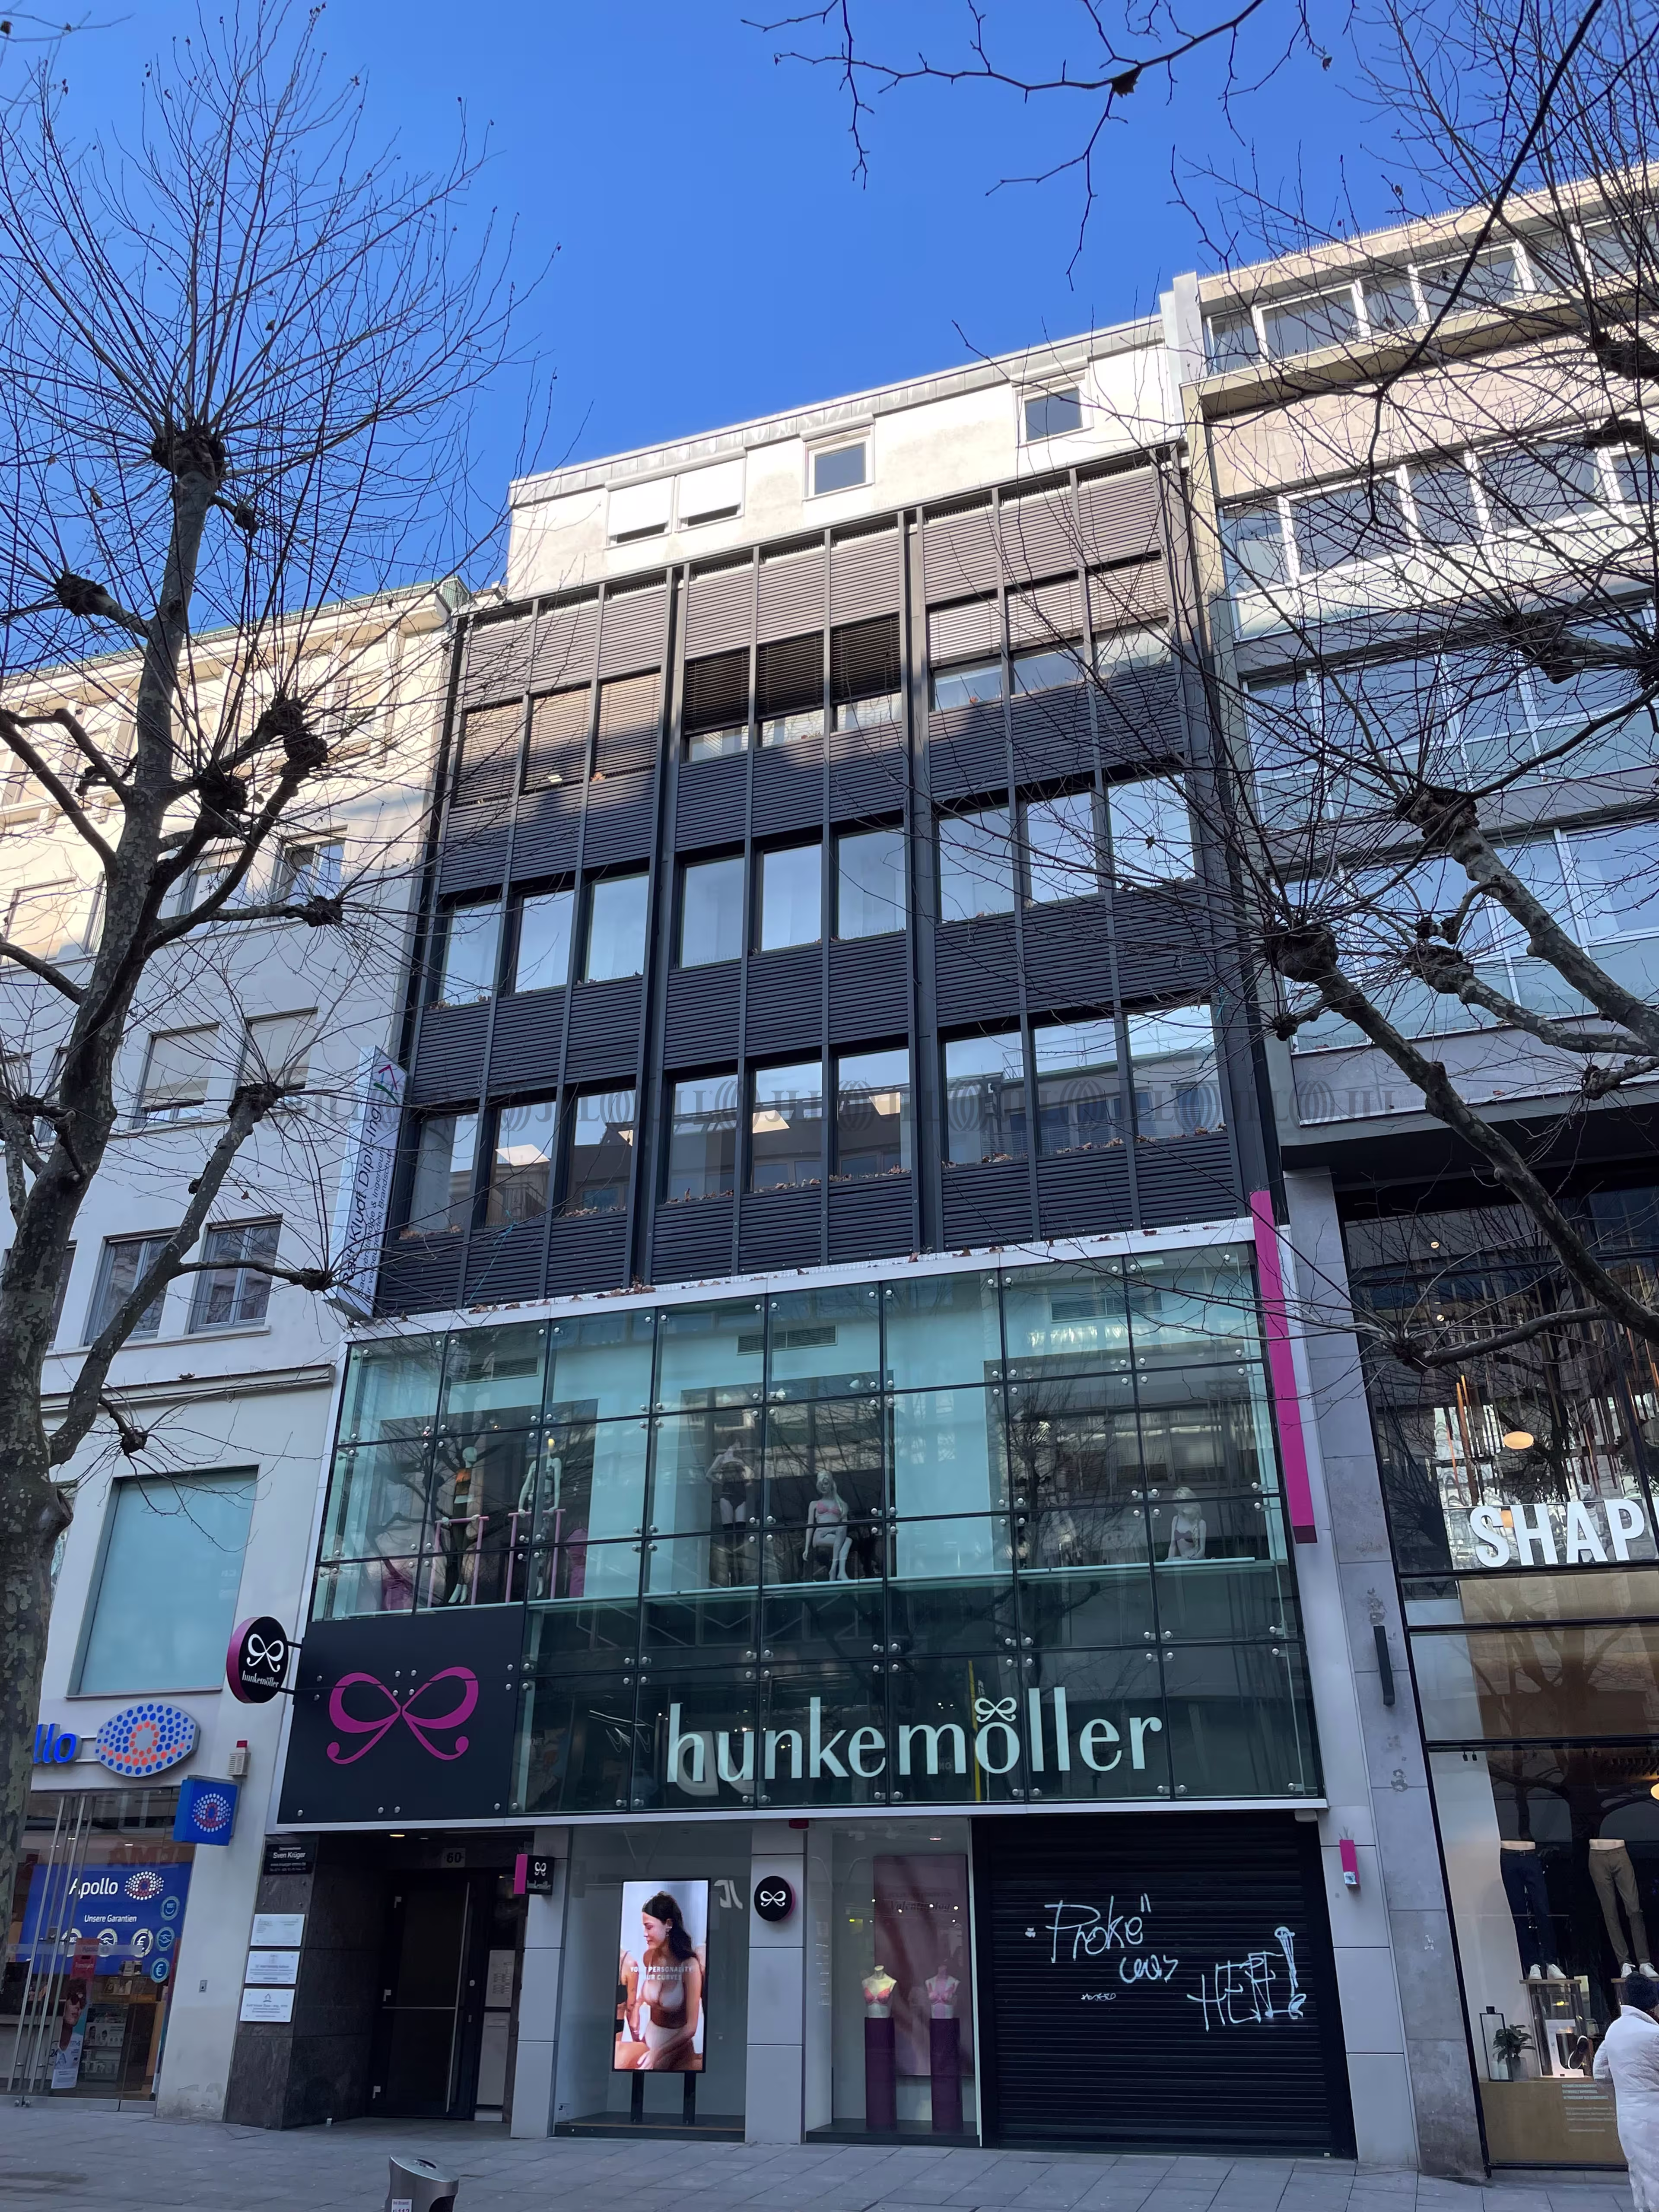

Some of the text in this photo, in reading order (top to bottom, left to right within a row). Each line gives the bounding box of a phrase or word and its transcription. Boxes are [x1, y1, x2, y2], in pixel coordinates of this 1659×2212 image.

[349, 1191, 367, 1242] Kludt
[1470, 1498, 1659, 1567] SHAP
[242, 1670, 279, 1688] hunkemöller
[33, 1723, 79, 1764] llo
[667, 1687, 1163, 1783] hunkemöller
[447, 1852, 461, 1863] 60
[69, 1877, 118, 1899] Apollo
[84, 1914, 137, 1923] Unsere Garantien
